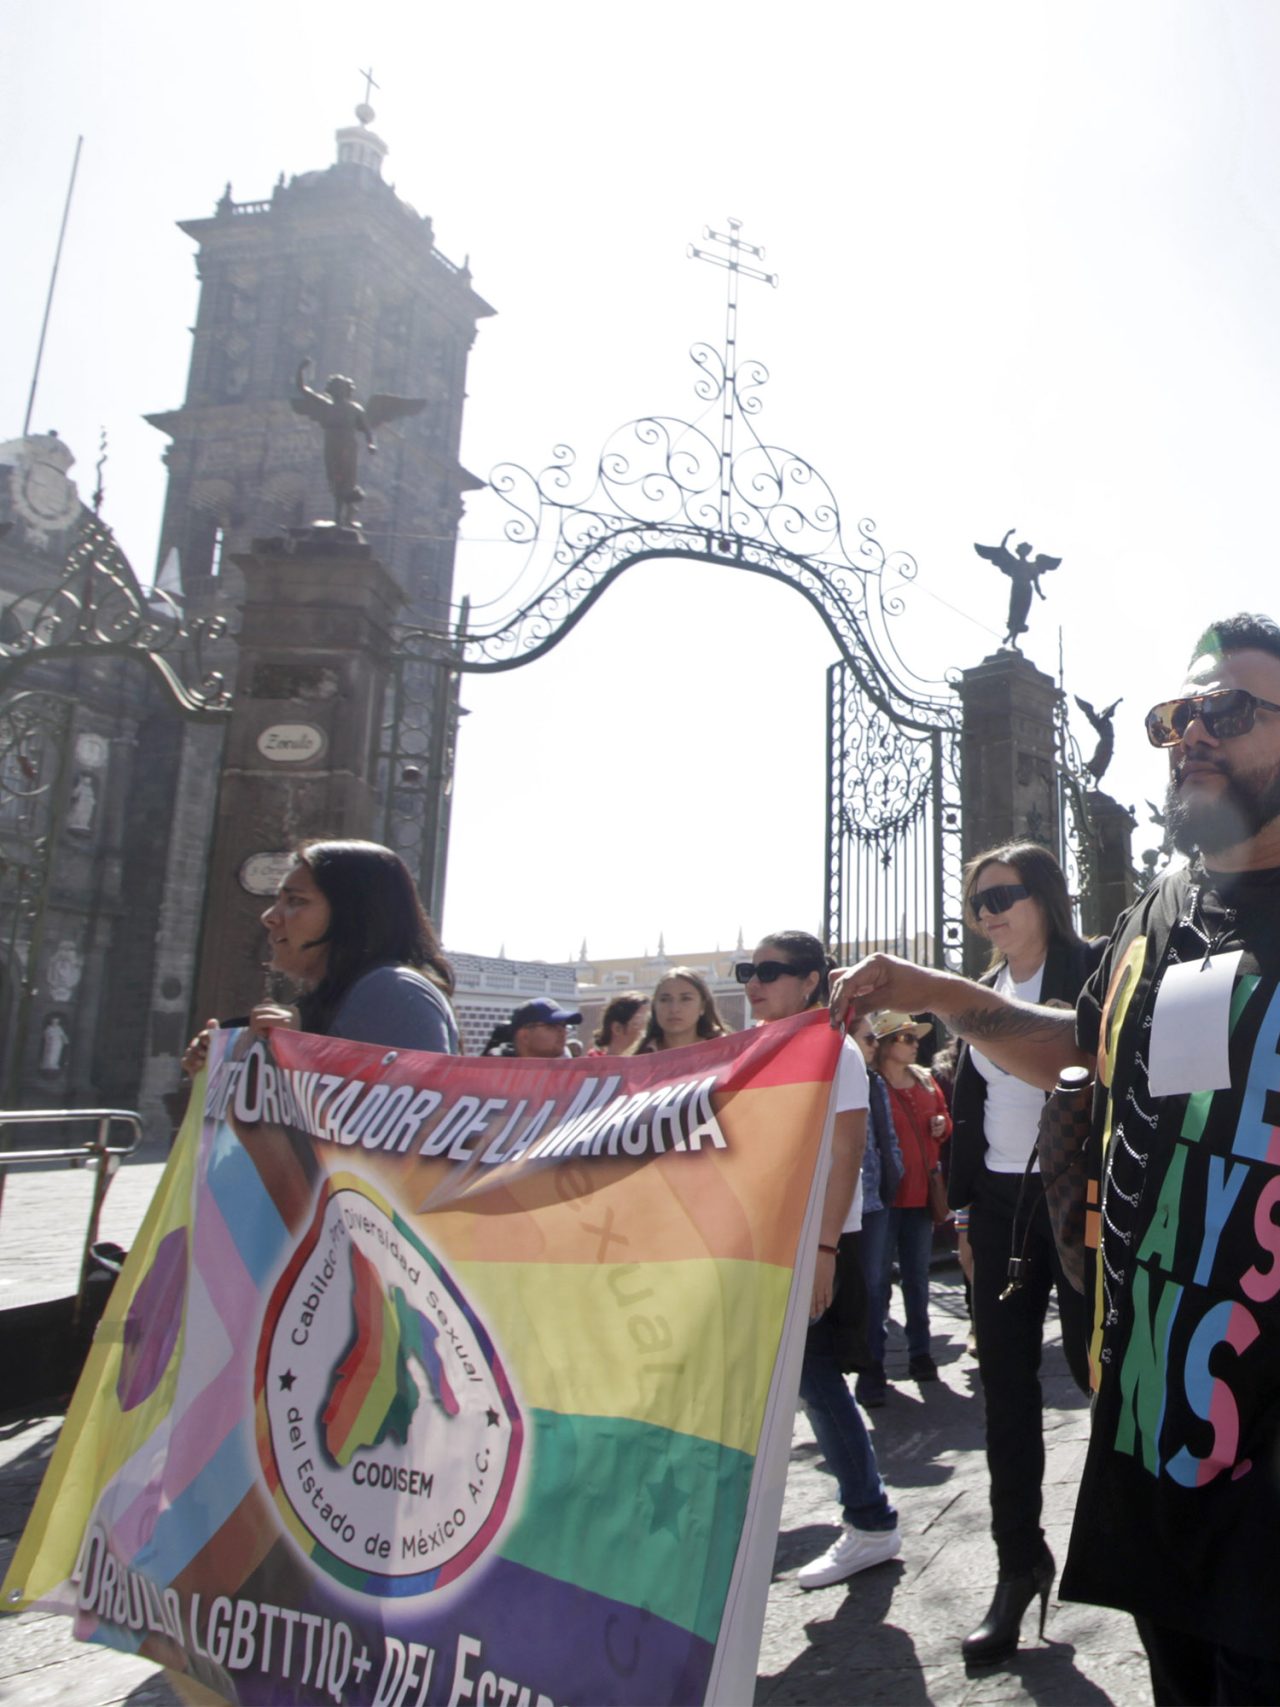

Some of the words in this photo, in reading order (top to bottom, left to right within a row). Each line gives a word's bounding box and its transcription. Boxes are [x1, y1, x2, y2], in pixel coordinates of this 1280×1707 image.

[234, 1041, 443, 1152] ORGANIZADOR
[419, 1095, 507, 1162] DE
[480, 1100, 556, 1165] LA
[528, 1075, 728, 1160] MARCHA
[291, 1249, 337, 1346] Cabildo
[344, 1208, 421, 1286] Diversidad
[426, 1290, 483, 1383] Sexual
[287, 1407, 306, 1451] del
[297, 1458, 356, 1543] Estado
[364, 1533, 391, 1559] de
[401, 1508, 466, 1560] México
[352, 1460, 434, 1499] CODISEM
[190, 1593, 372, 1704] LGBTTTIQ+
